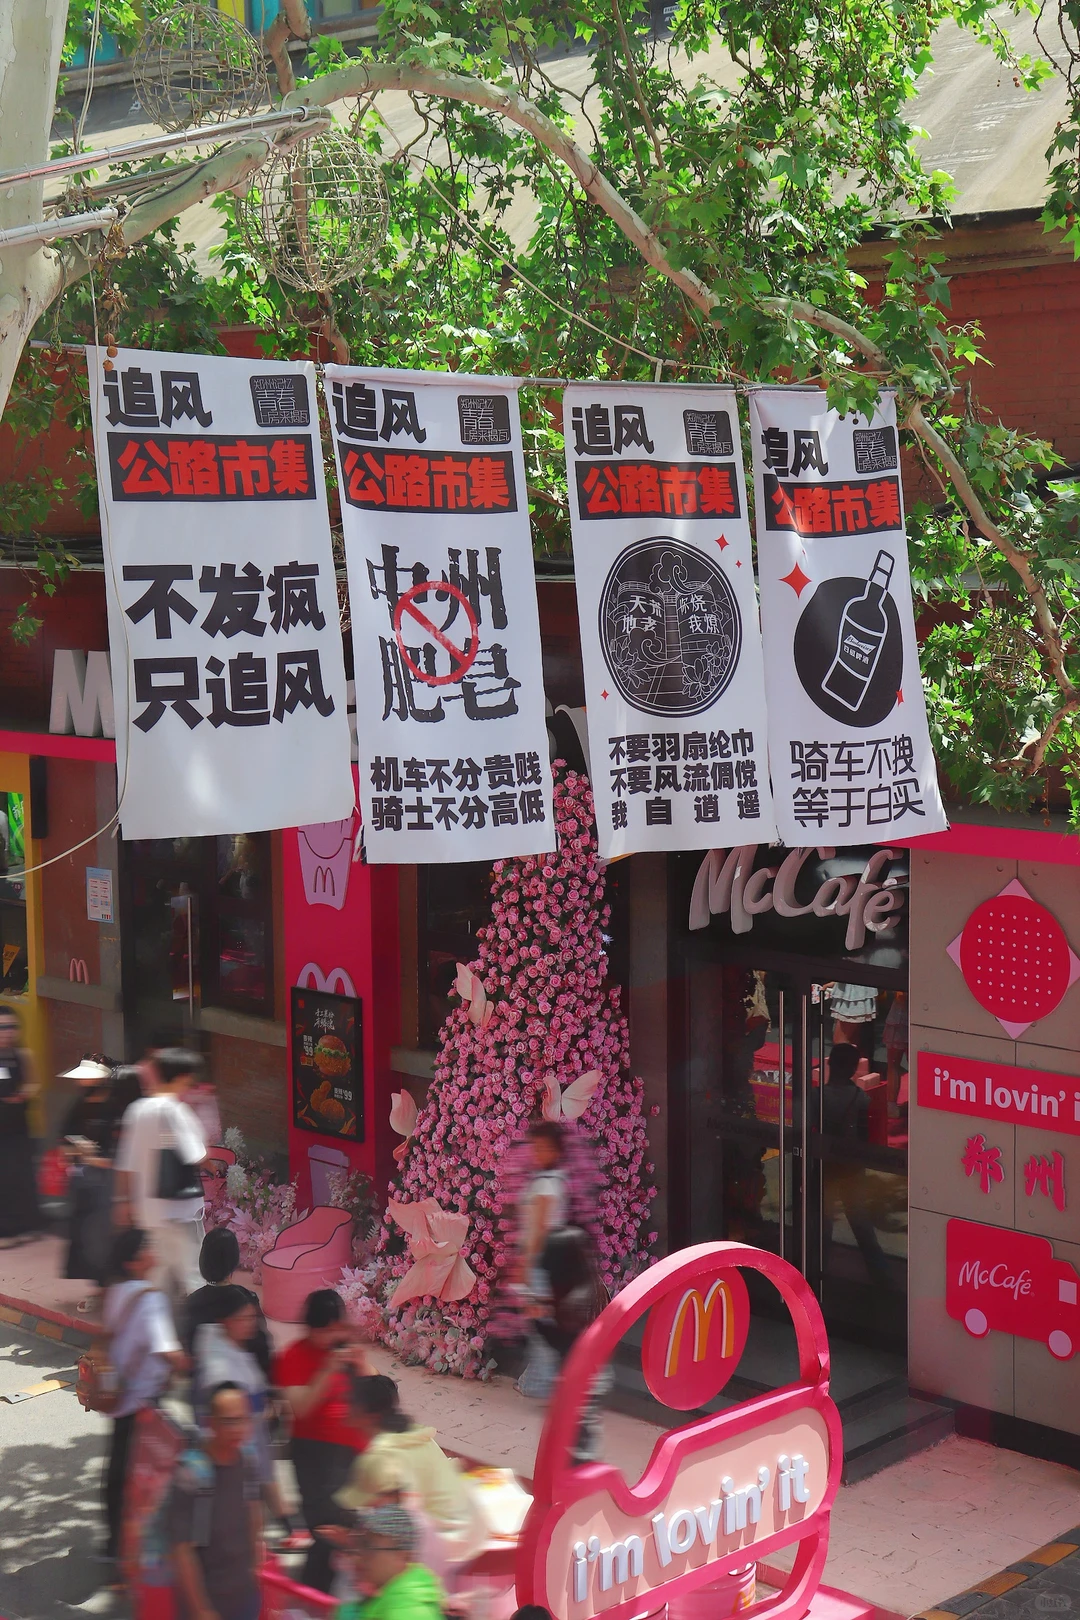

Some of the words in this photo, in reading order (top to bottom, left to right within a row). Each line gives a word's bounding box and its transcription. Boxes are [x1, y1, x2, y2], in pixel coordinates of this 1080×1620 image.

[102, 366, 213, 428] 追风
[255, 389, 296, 411] 青春
[331, 382, 427, 444] 追风
[462, 408, 495, 429] 青春
[571, 403, 655, 457] 追风
[688, 422, 717, 443] 青春
[761, 426, 829, 477] 追风
[856, 440, 886, 460] 青春
[117, 439, 310, 496] 公路市集
[343, 450, 511, 510] 公路市集
[582, 464, 735, 516] 公路市集
[122, 560, 327, 640] 不发疯
[365, 543, 509, 631] 中州
[132, 649, 336, 733] 只追风
[378, 635, 522, 723] 肥皂
[370, 751, 543, 793] 机车不分贵贱
[608, 728, 754, 766] 不要羽扇纶巾
[789, 733, 917, 783] 骑车不拽
[609, 760, 758, 798] 不要风流倜傥
[791, 778, 926, 829] 等于白买
[371, 788, 546, 832] 骑士不分高低
[611, 790, 761, 831] 我自逍遥
[688, 842, 910, 951] McCafé
[961, 1133, 1067, 1213] 郑州
[777, 1453, 811, 1512] it
